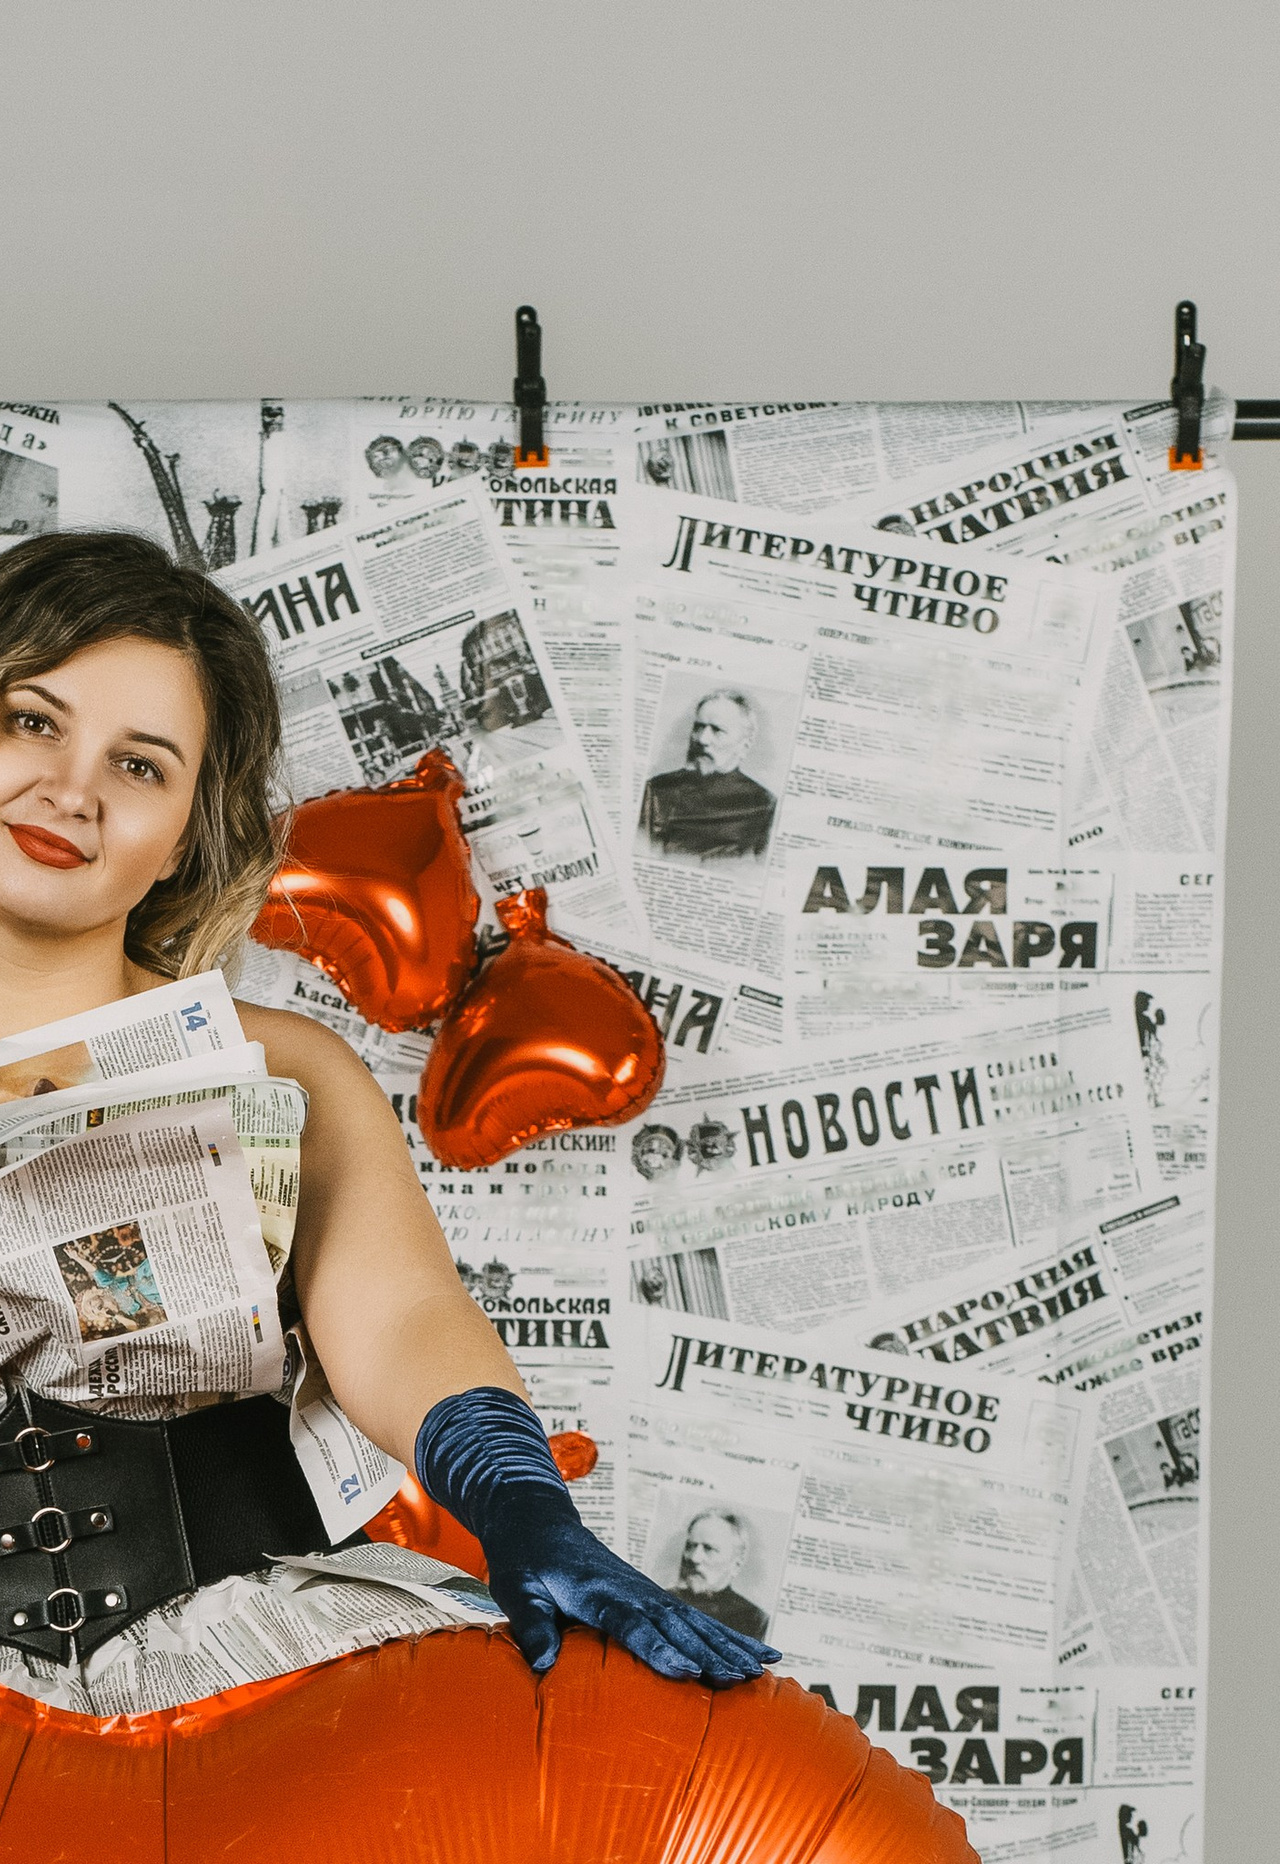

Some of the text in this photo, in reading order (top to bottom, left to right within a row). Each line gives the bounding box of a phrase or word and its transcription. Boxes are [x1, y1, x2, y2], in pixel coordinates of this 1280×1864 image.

[486, 477, 617, 495] ОМОЛЬСКАЯ
[908, 433, 1122, 525] НАРОДНАЯ
[491, 499, 617, 530] ТИНА
[1173, 516, 1228, 545] вра
[662, 514, 1010, 603] ЛИТЕРАТУРНОЕ
[850, 582, 1001, 635] ЧТИВО
[802, 865, 1009, 915] АЛАЯ
[916, 920, 1098, 969] ЗАРЯ
[180, 1001, 209, 1032] 14
[739, 1066, 985, 1168] НОВОСТИ
[901, 1245, 1098, 1345] НАРОДНАЯ
[1151, 1335, 1204, 1364] вра
[654, 1333, 1001, 1424] ЛИТЕРАТУРНОЕ
[843, 1402, 992, 1454] ЧТИВО
[340, 1472, 363, 1506] 12
[910, 1736, 1085, 1785] ЗАРЯ
